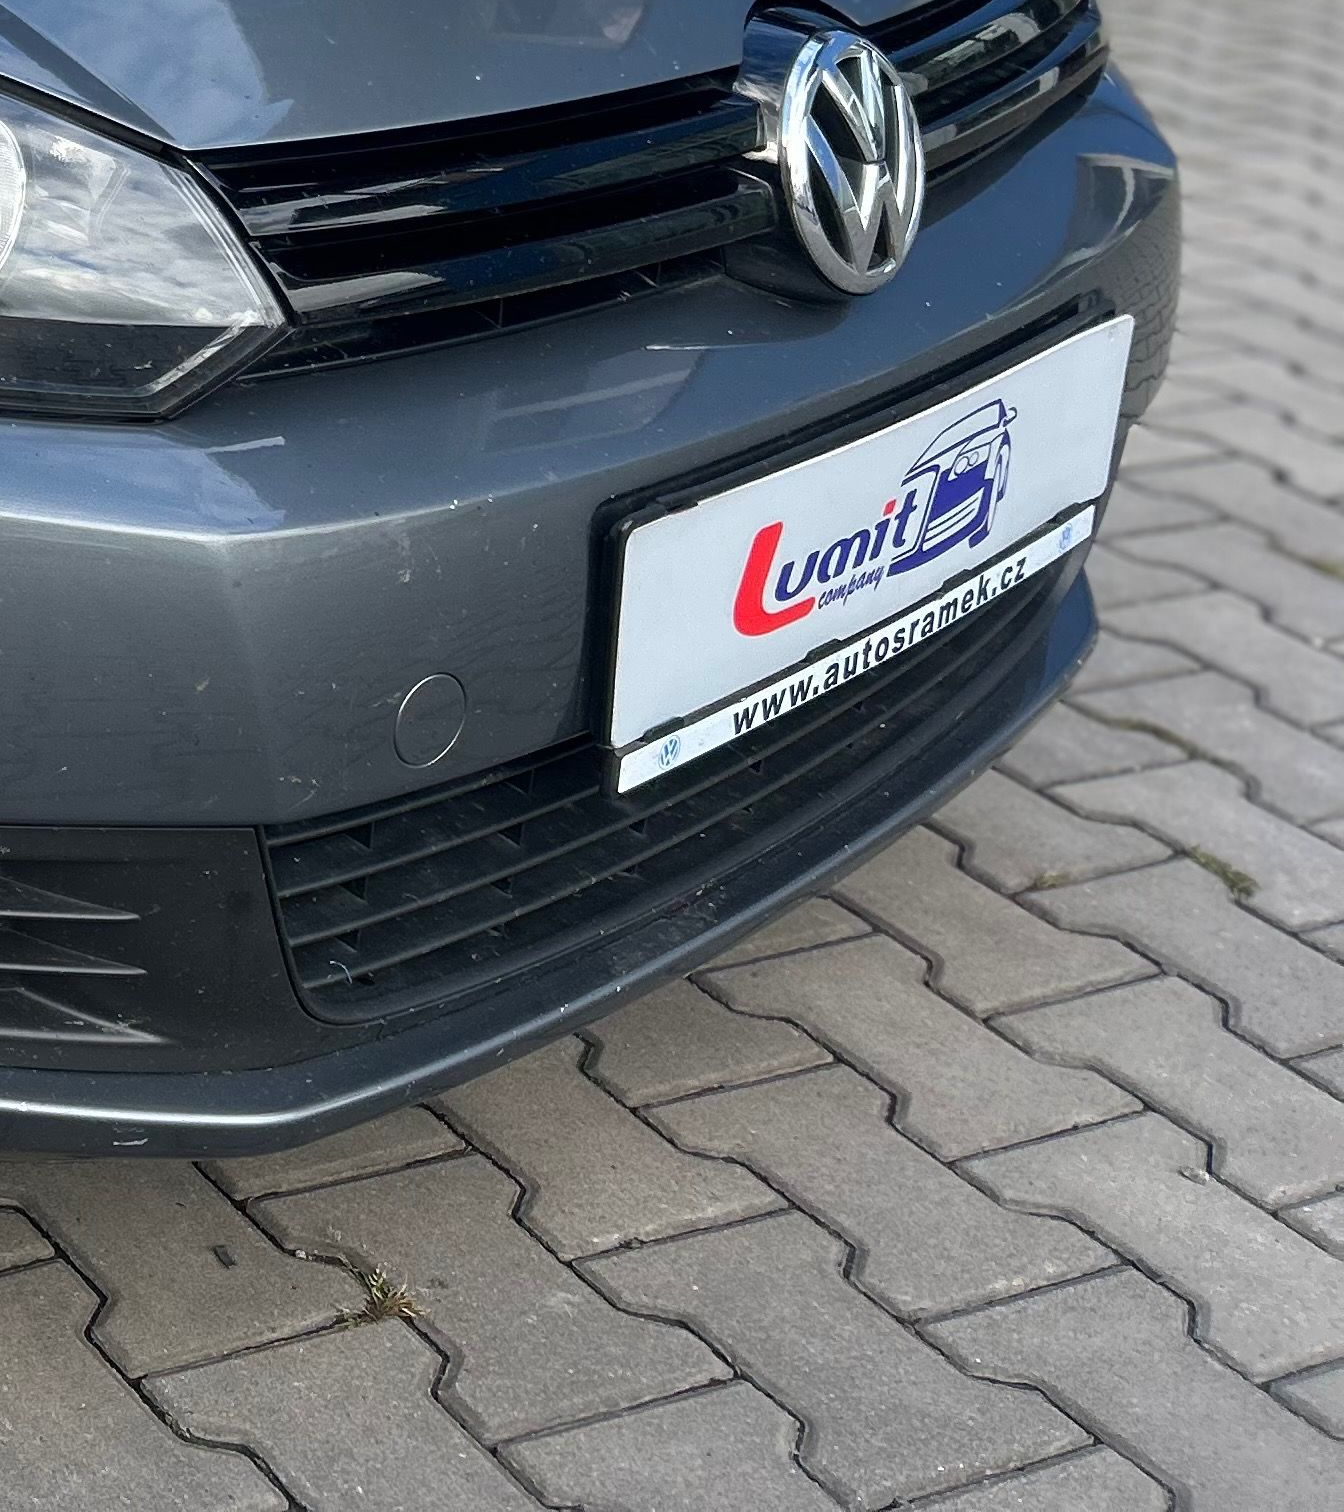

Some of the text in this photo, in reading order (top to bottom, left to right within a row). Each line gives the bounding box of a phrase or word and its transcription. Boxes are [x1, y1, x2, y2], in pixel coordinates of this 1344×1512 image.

[734, 489, 918, 637] Lumit
[818, 565, 885, 610] company
[733, 556, 1028, 736] www.autosramek.cz
